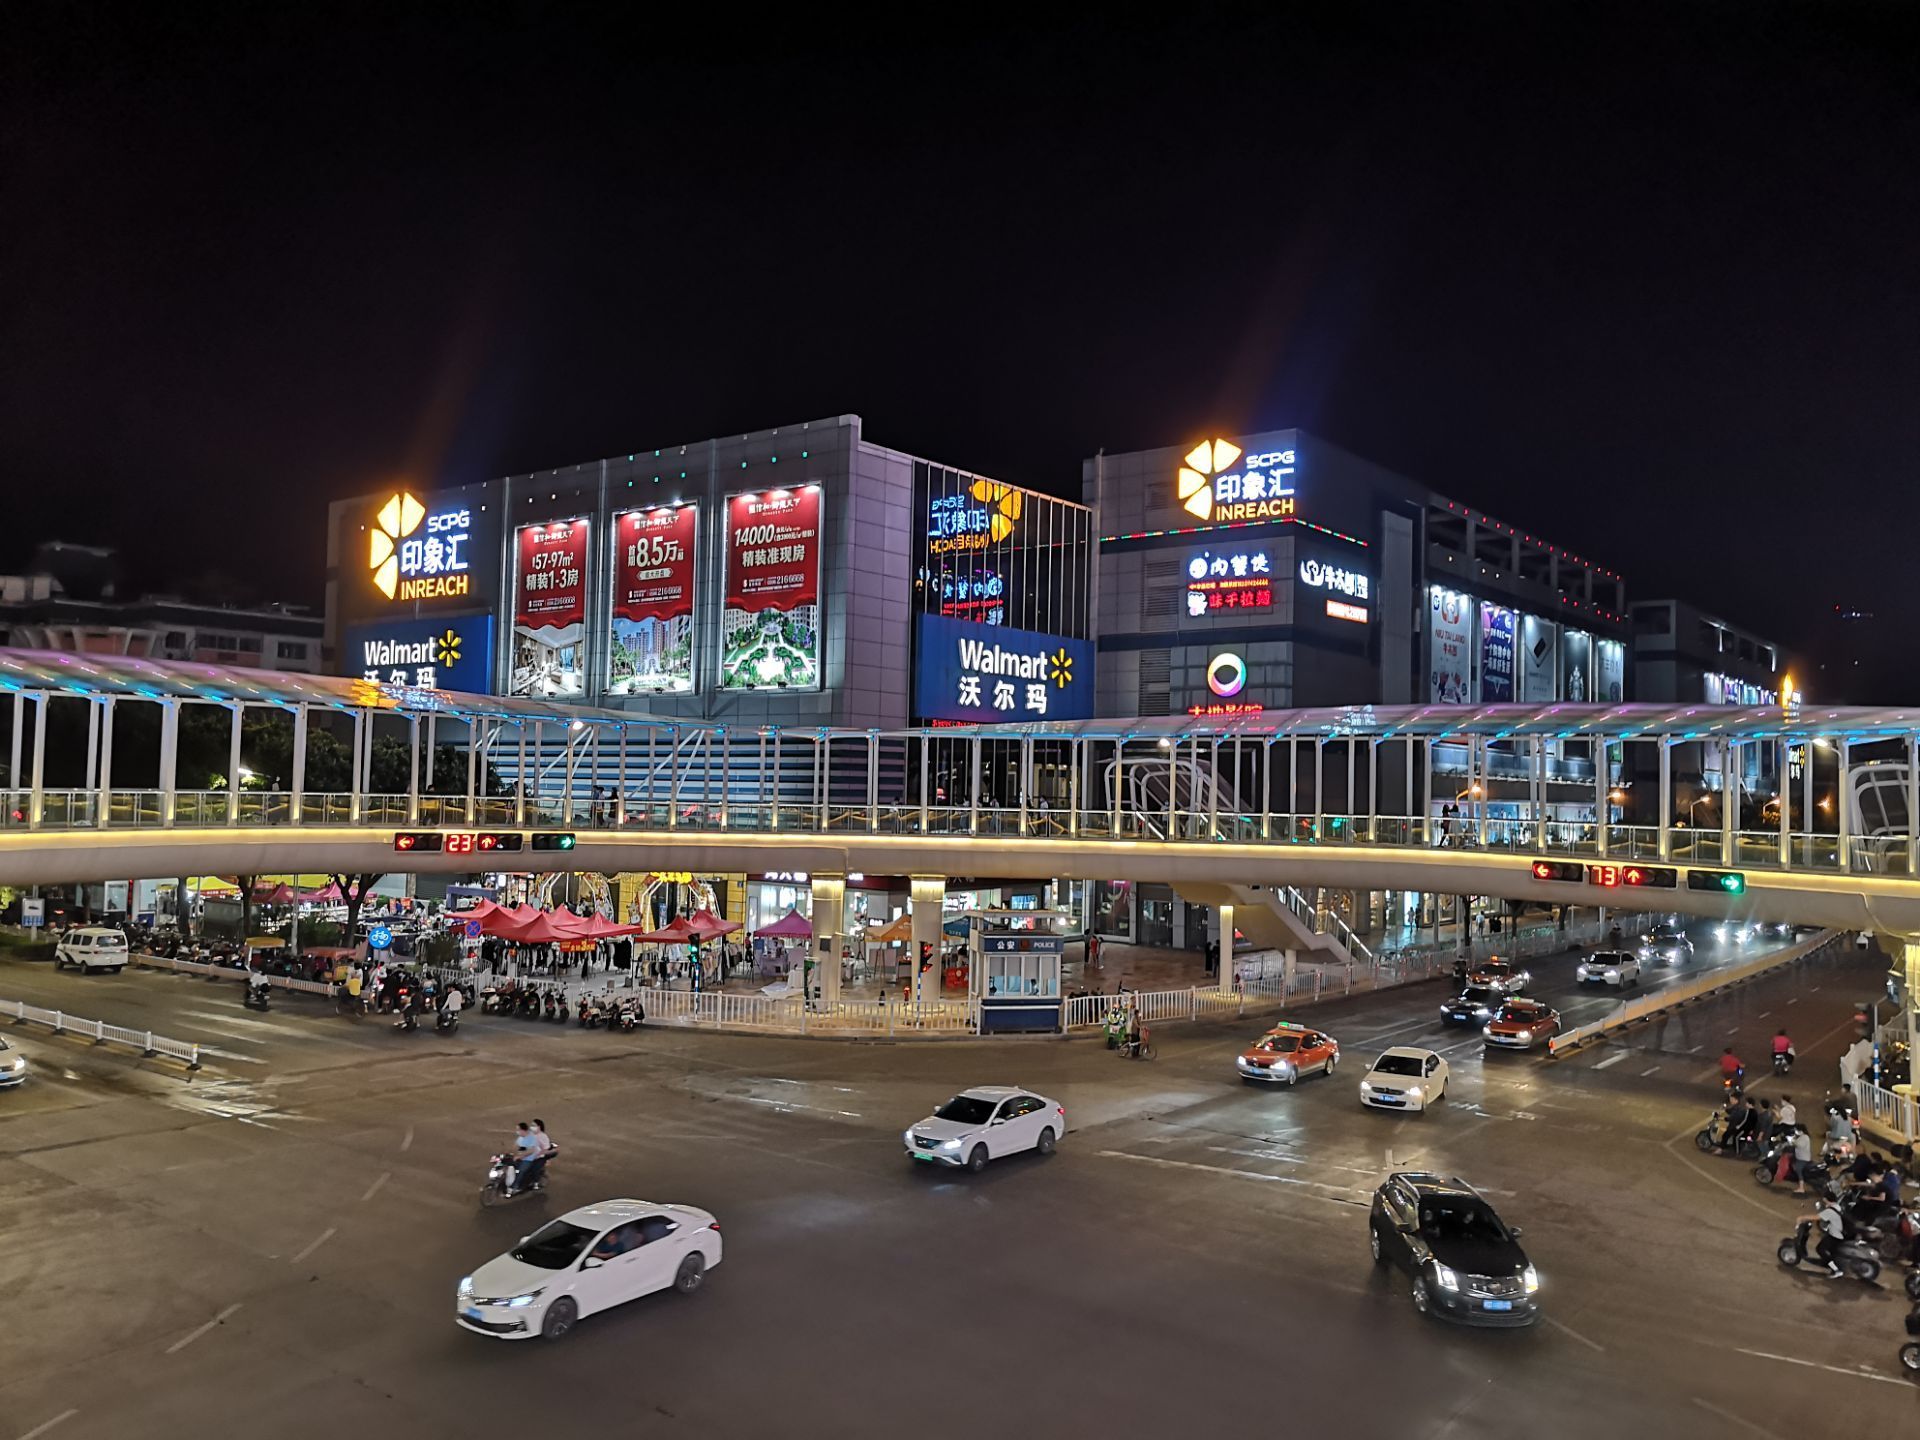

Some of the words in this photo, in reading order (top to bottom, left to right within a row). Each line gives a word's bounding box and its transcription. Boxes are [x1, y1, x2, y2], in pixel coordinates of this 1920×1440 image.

[1246, 450, 1295, 469] SCPG
[1216, 468, 1295, 503] 印象汇
[428, 510, 470, 533] SCPG
[1216, 499, 1294, 521] INREACH
[735, 524, 775, 547] 14000
[401, 533, 469, 577] 印象汇
[742, 544, 805, 567] 精装准现房
[401, 574, 468, 600] INREACH
[526, 568, 579, 591] 精装1-3房
[364, 636, 438, 666] Walmart
[959, 638, 1048, 681] Walmart
[363, 666, 438, 690] 沃尔玛
[959, 676, 1047, 715] 沃尔玛
[449, 835, 471, 851] 23
[997, 940, 1015, 950] 公安
[1033, 941, 1056, 949] POLICE
